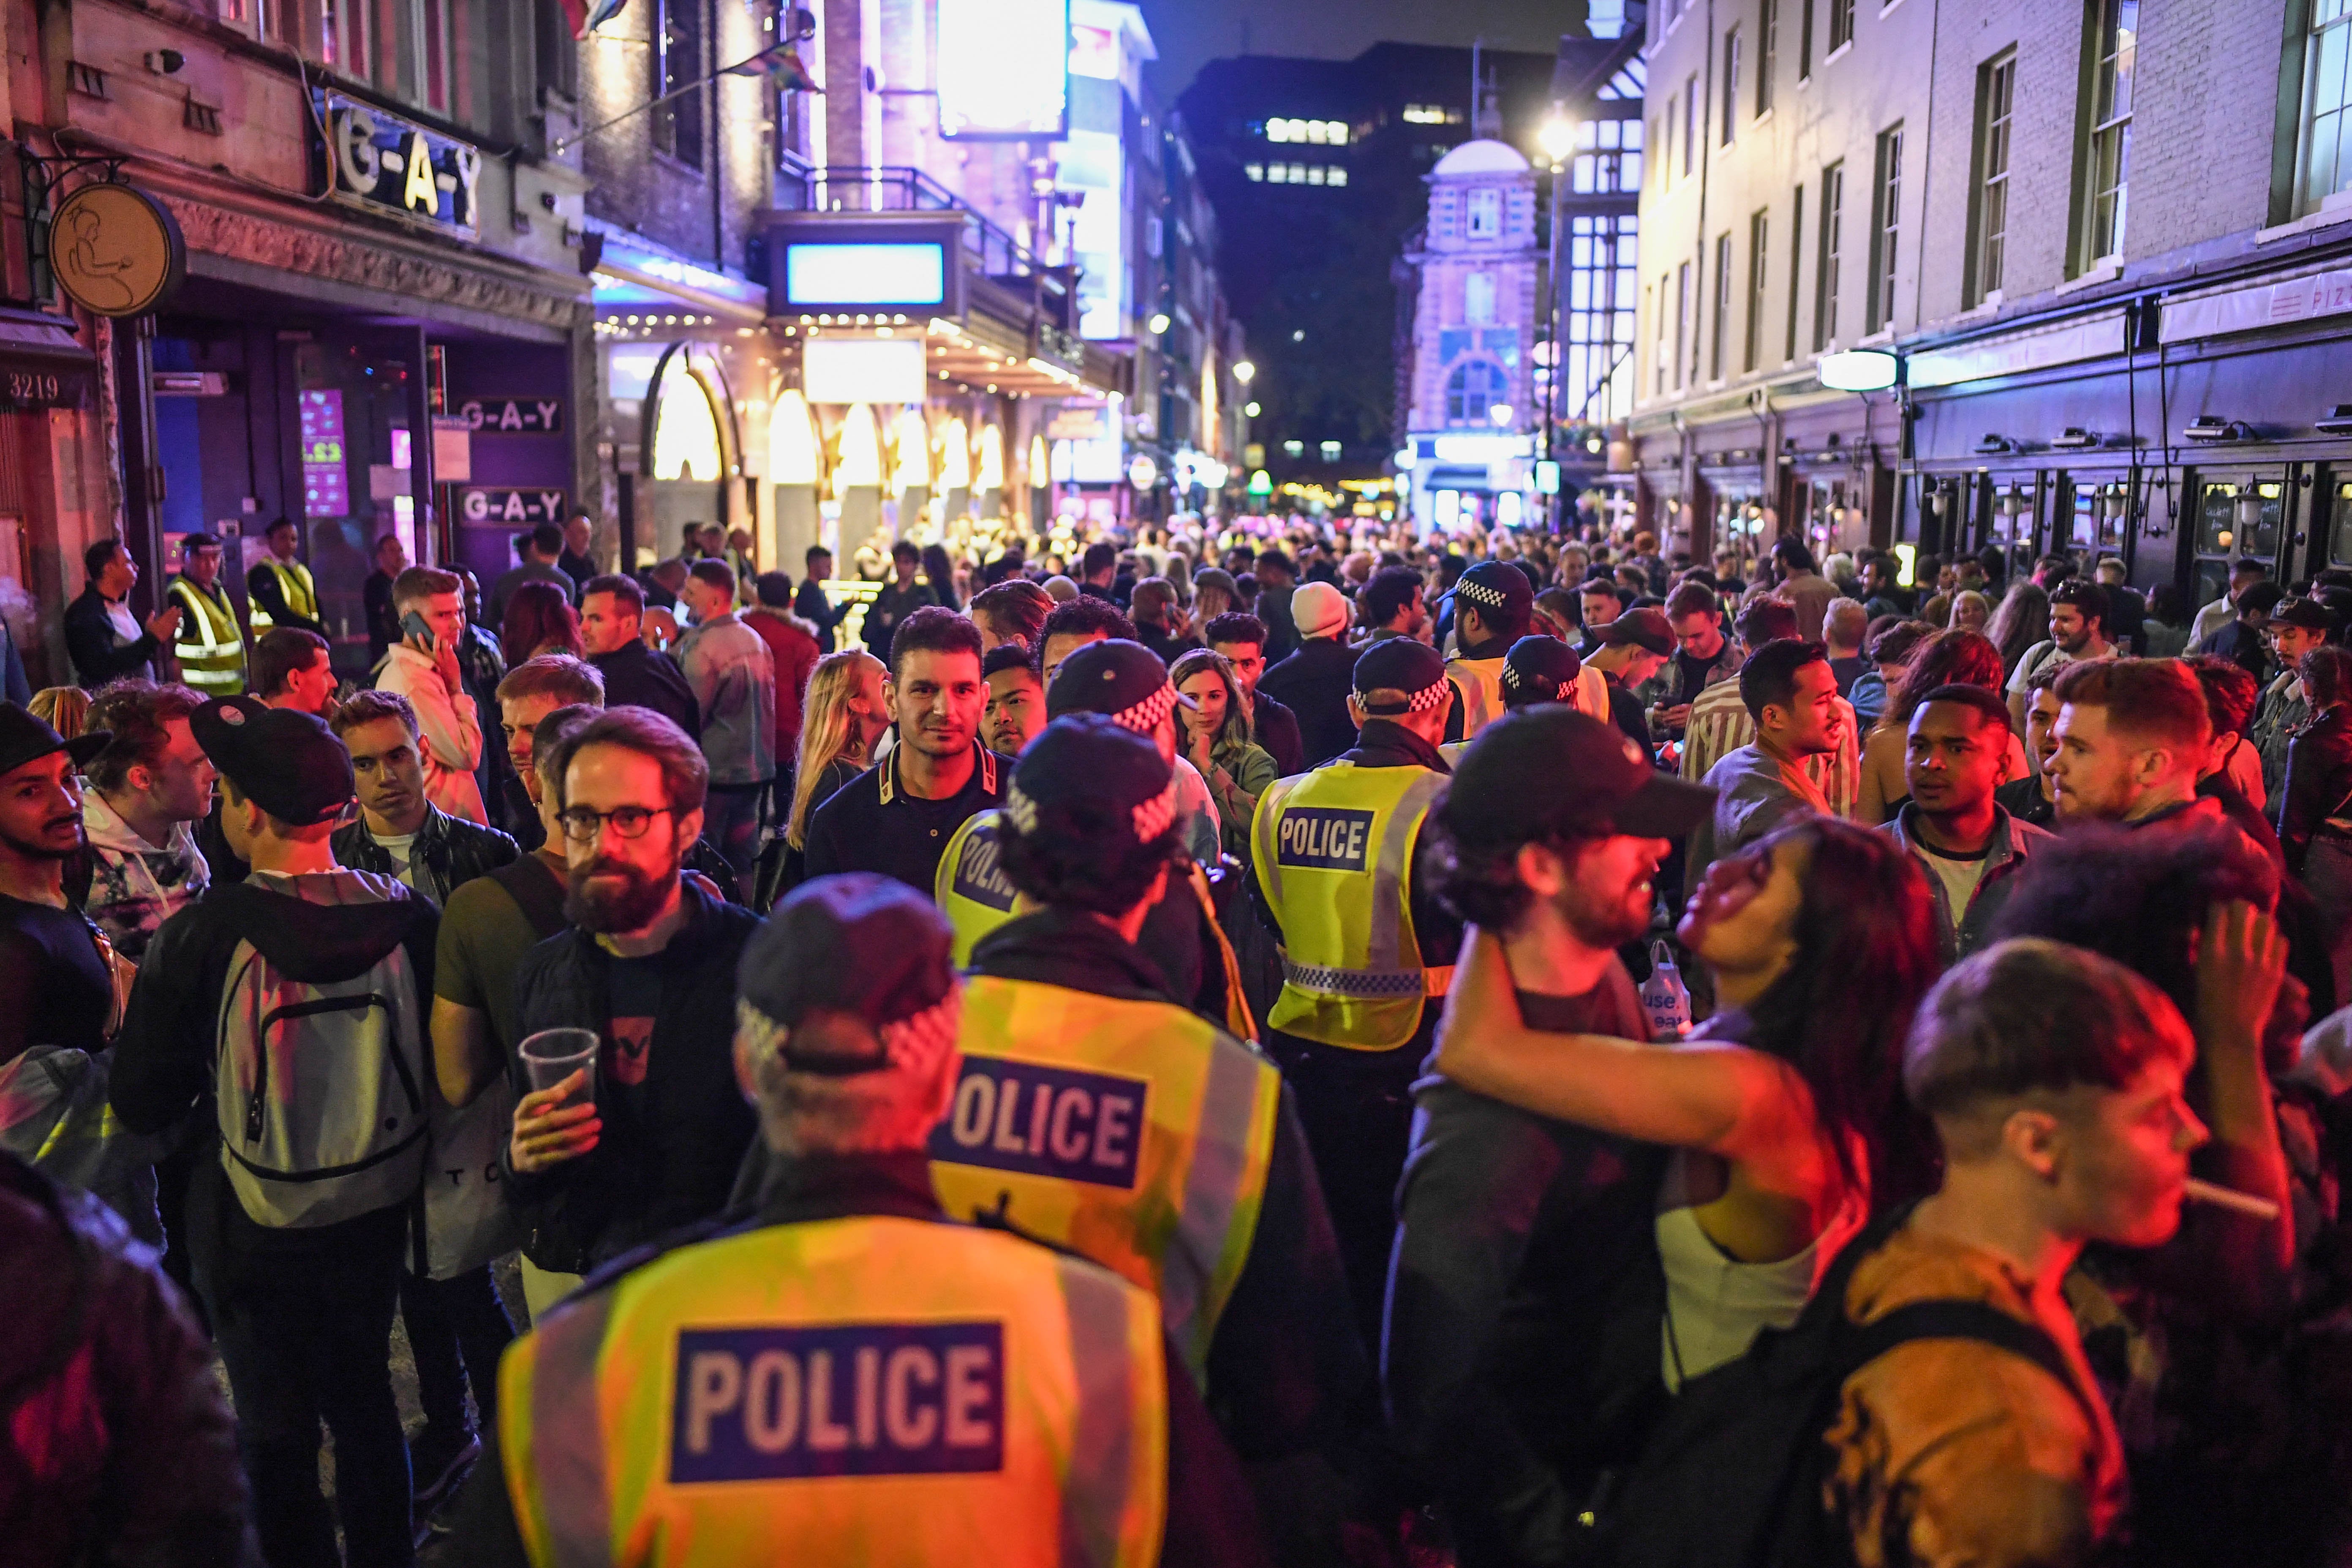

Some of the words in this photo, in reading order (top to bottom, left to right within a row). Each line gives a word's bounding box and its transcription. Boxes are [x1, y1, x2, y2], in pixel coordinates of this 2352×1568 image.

[339, 107, 481, 226] G-A-Y
[10, 373, 58, 399] 3219
[460, 401, 557, 430] G-A-Y
[465, 490, 561, 520] G-A-Y
[1280, 817, 1365, 859] POLICE
[957, 834, 1015, 897] POLI
[953, 1073, 1134, 1169] OLICE
[685, 1345, 992, 1456] POLICE
